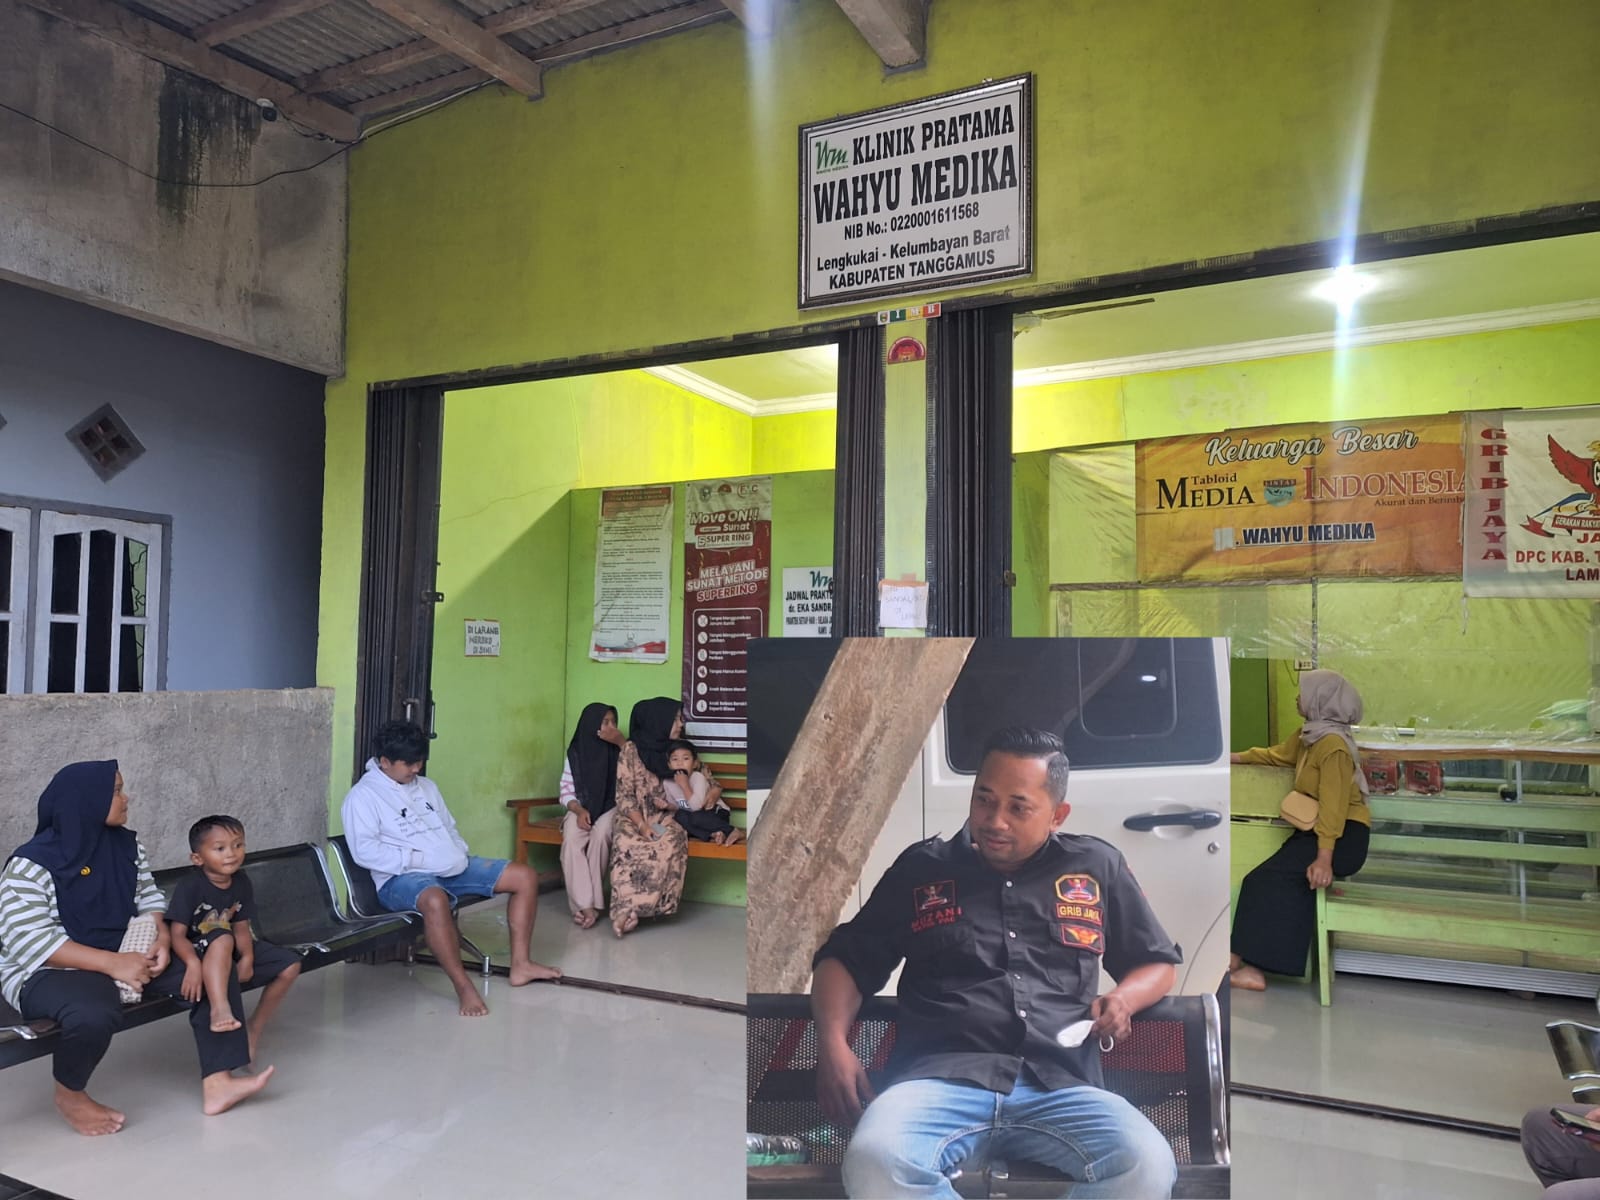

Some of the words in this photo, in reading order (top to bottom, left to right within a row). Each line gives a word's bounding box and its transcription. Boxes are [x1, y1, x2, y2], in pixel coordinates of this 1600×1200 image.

[852, 126, 915, 166] KLINIK
[921, 104, 1015, 151] PRATAMA
[813, 167, 902, 225] WAHYU
[911, 145, 1018, 206] MEDIKA
[844, 223, 864, 241] NIB
[866, 220, 888, 236] No.:
[890, 201, 980, 232] 0220001611568
[817, 247, 879, 272] Lengkukai
[890, 233, 969, 260] Kelumbayan
[973, 225, 1011, 246] Barat
[829, 264, 905, 290] KABUPATEN
[909, 249, 996, 281] TANGGAMUS
[1205, 436, 1326, 465] Keluarga
[1332, 426, 1419, 456] Besar
[1480, 428, 1509, 490] GRIB
[1191, 472, 1237, 486] Tabloid
[1408, 497, 1426, 505] dan
[690, 510, 727, 525] Move
[723, 523, 750, 532] Sunat
[706, 535, 730, 543] SUPER
[731, 534, 751, 542] RING
[1243, 526, 1304, 545] WAHYU
[1307, 522, 1376, 542] MEDIKA
[1481, 498, 1507, 561] JAYA
[1515, 550, 1546, 563] DPC
[1552, 550, 1590, 564] KAB.
[700, 559, 756, 579] MELAYANI
[686, 576, 721, 592] SUNAT
[724, 567, 769, 587] METODE
[697, 582, 758, 602] SUPERRING
[786, 591, 809, 601] JADWAL
[797, 603, 810, 613] EKA
[1059, 905, 1082, 917] GRIB
